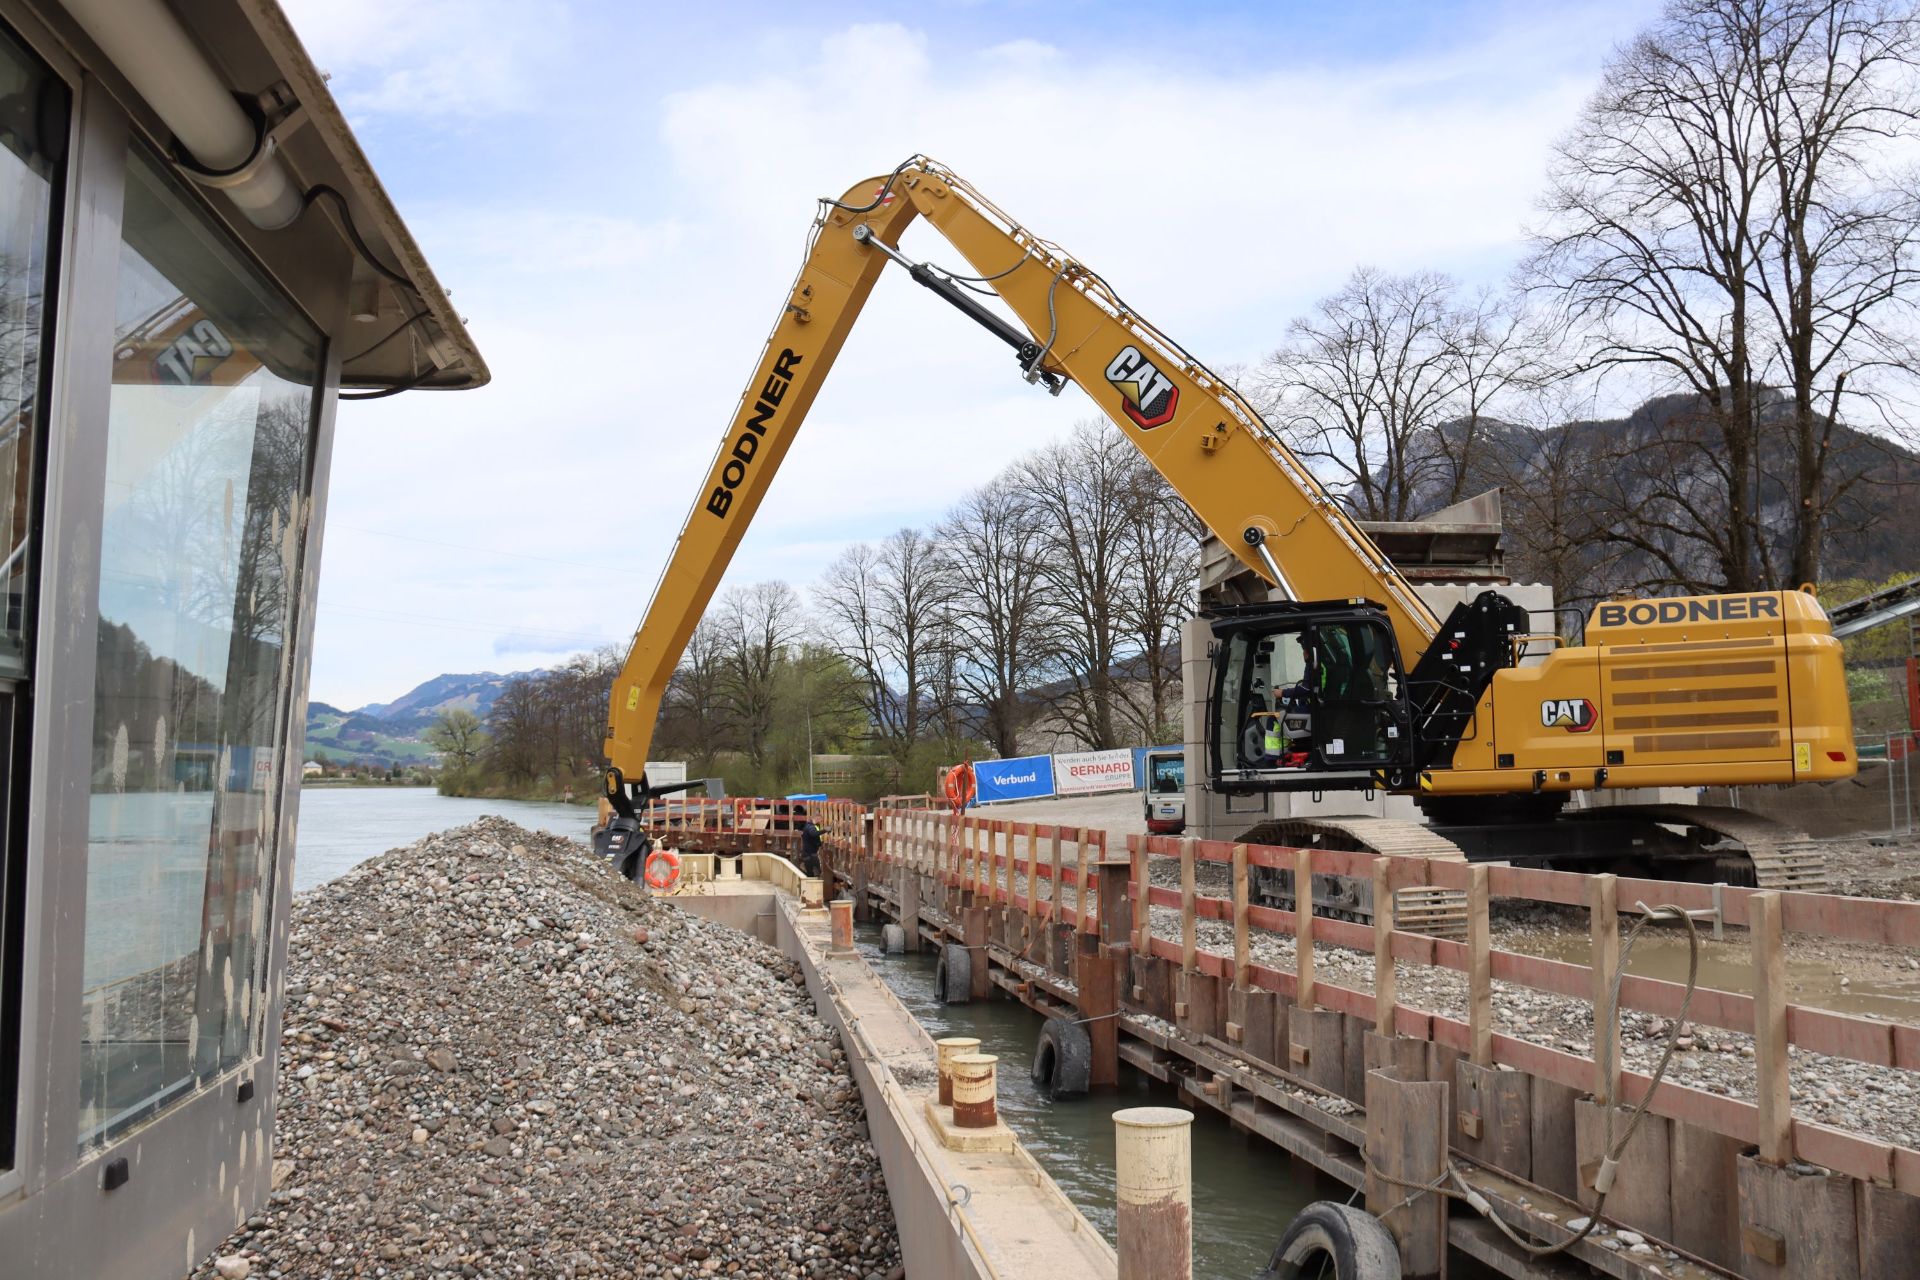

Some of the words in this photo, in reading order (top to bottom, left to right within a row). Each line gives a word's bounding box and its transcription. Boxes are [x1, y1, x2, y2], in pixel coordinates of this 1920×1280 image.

[1105, 345, 1174, 412] CAT
[706, 348, 803, 520] BODNER
[1599, 596, 1780, 627] BODNER
[1541, 699, 1584, 727] CAT
[1070, 762, 1131, 776] BERNARD
[1082, 755, 1097, 763] auch
[993, 771, 1036, 785] Verbund
[1104, 773, 1131, 781] GRUPPE
